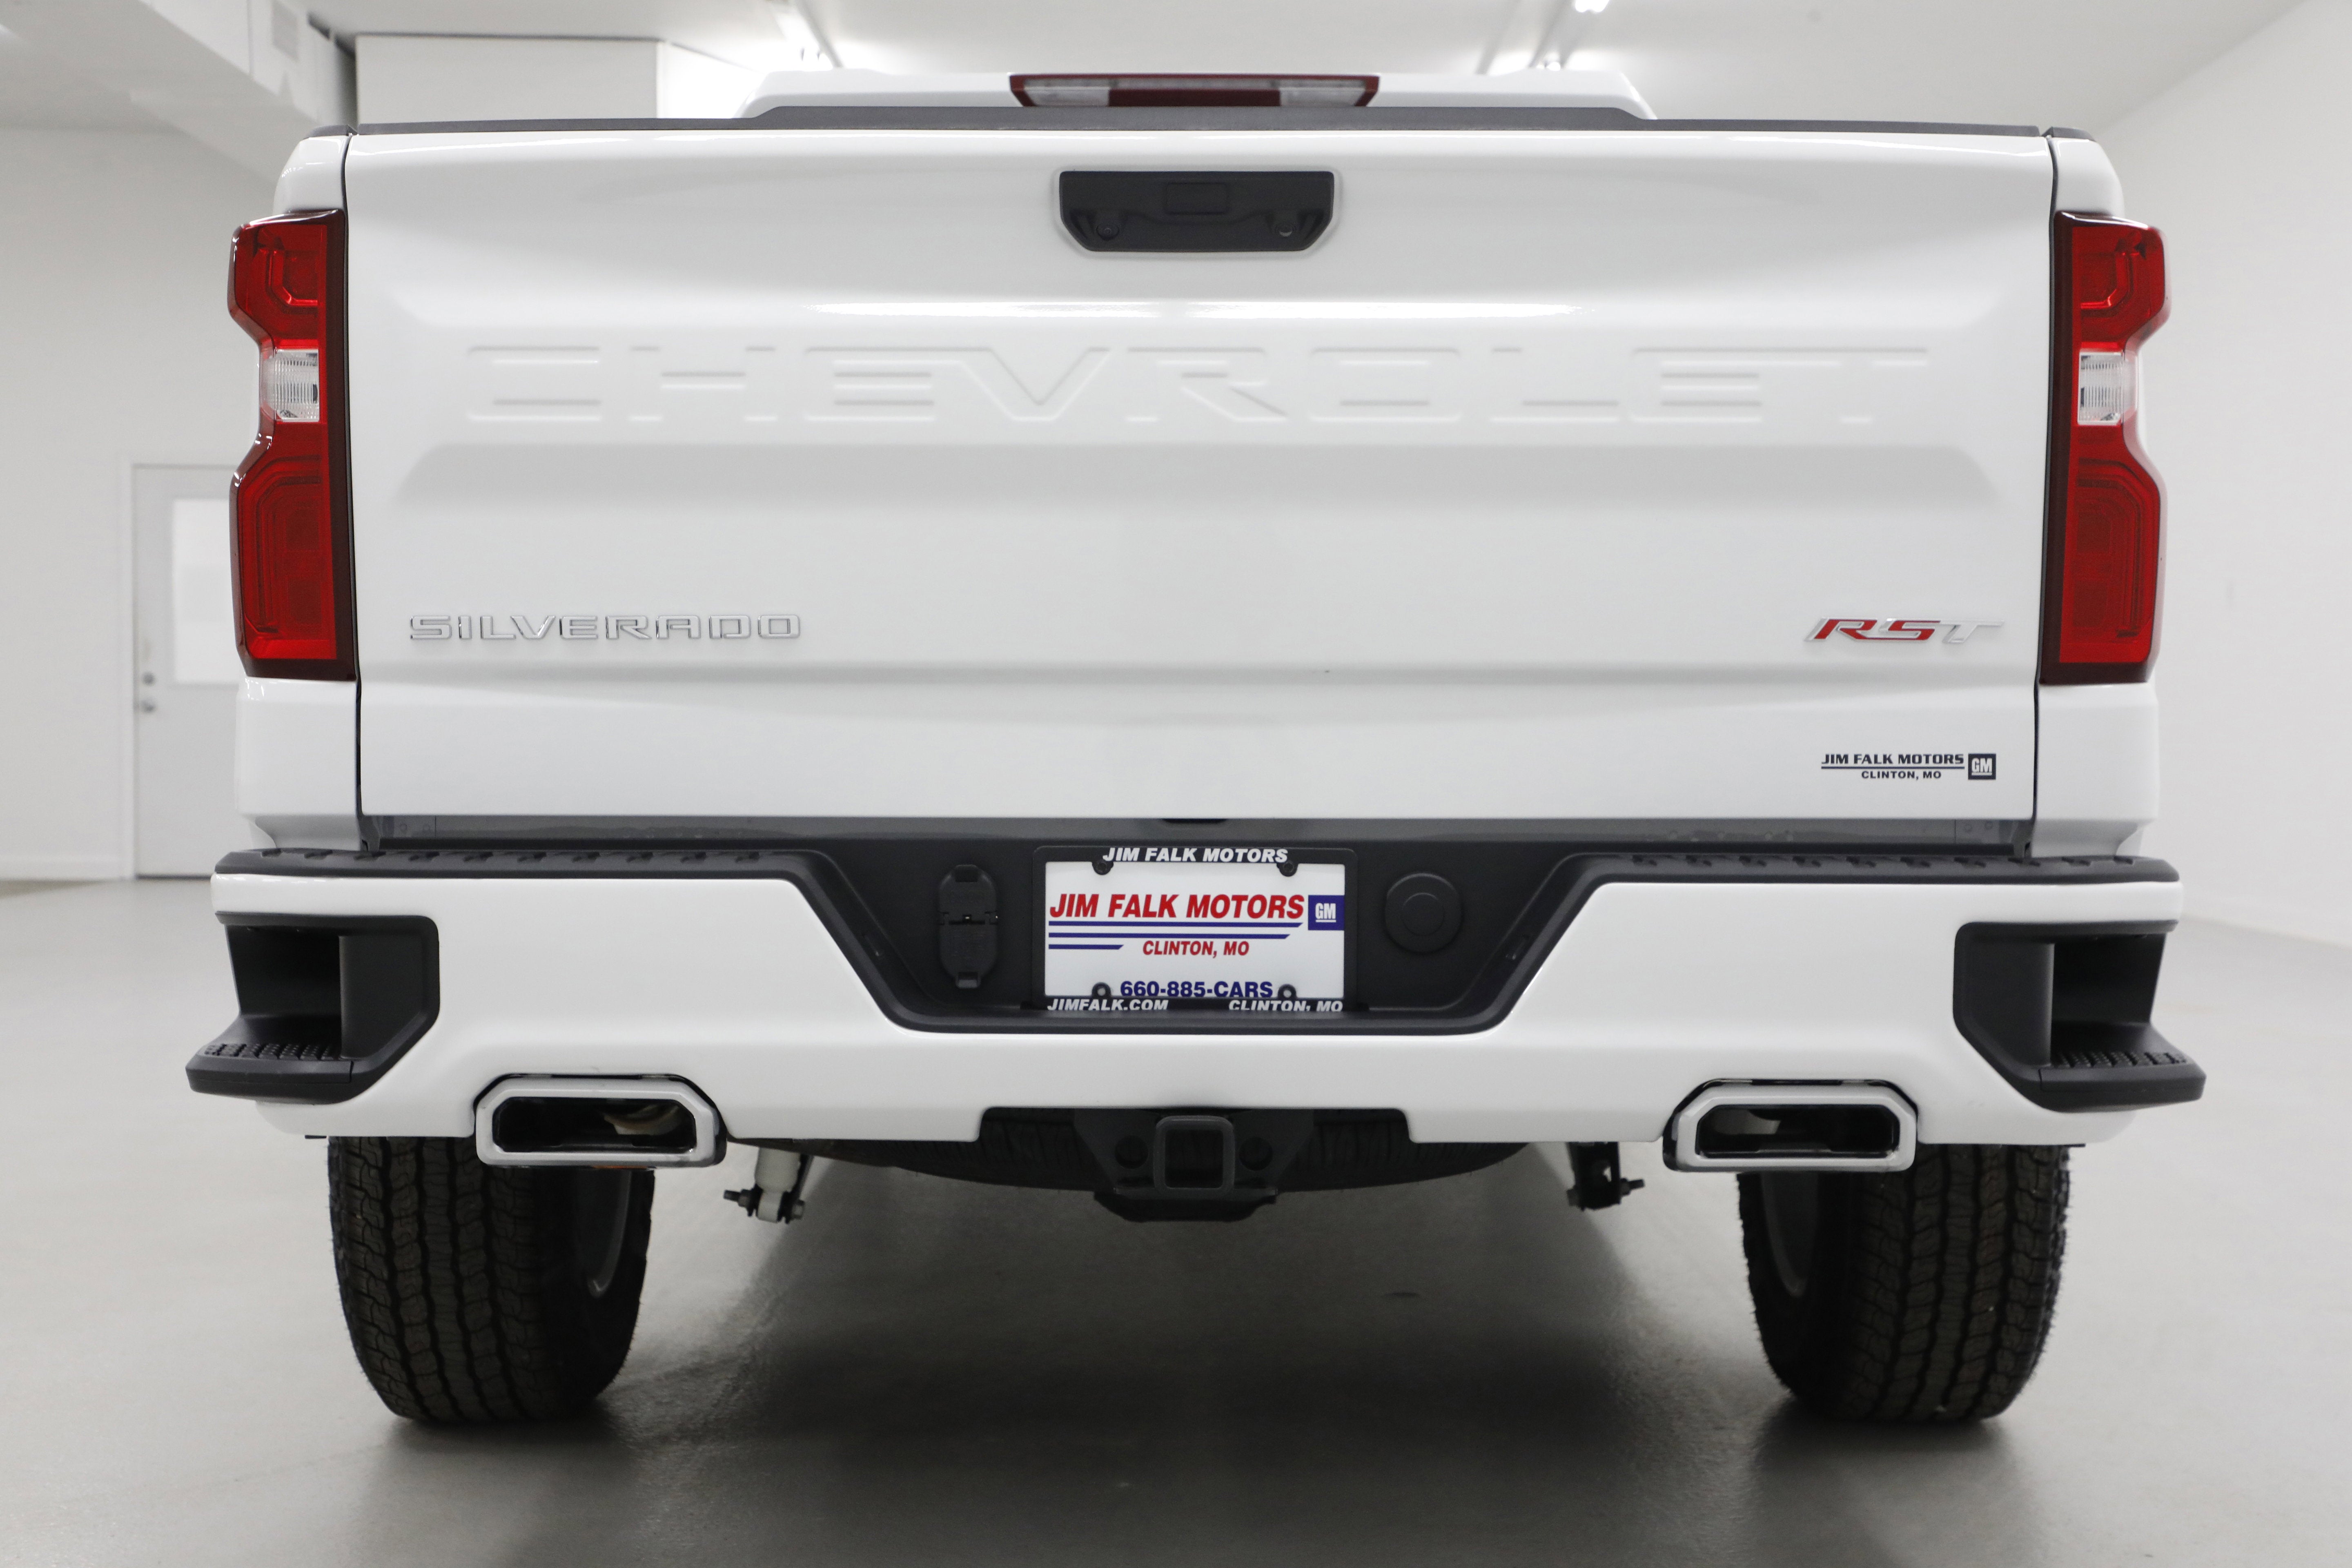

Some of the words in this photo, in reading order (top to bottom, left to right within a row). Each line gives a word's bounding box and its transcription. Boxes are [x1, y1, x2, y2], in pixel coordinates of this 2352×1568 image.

[467, 346, 1929, 423] CHEVROLET
[410, 615, 801, 640] SILVERADO
[1804, 617, 2005, 644] RST
[1822, 754, 1848, 764] JIM
[1854, 754, 1892, 764] FALK
[1898, 754, 1964, 764] MOTORS
[1971, 758, 1993, 773] GM
[1861, 771, 1919, 781] CLINTON,
[1102, 847, 1140, 862] JIM
[1145, 847, 1197, 862] FALK
[1202, 848, 1288, 863] MOTORS
[1049, 893, 1099, 918] JIM
[1107, 893, 1180, 918] FALK
[1186, 894, 1304, 919] MOTORS
[1314, 903, 1336, 920] GM
[1142, 940, 1218, 958] CLINTON,
[1223, 941, 1250, 956] MO
[1120, 981, 1273, 998] 660-885-CARS
[1047, 999, 1169, 1011] JIMFALK.COM
[1228, 1000, 1311, 1012] CLINTON,
[1316, 1000, 1343, 1012] MO
